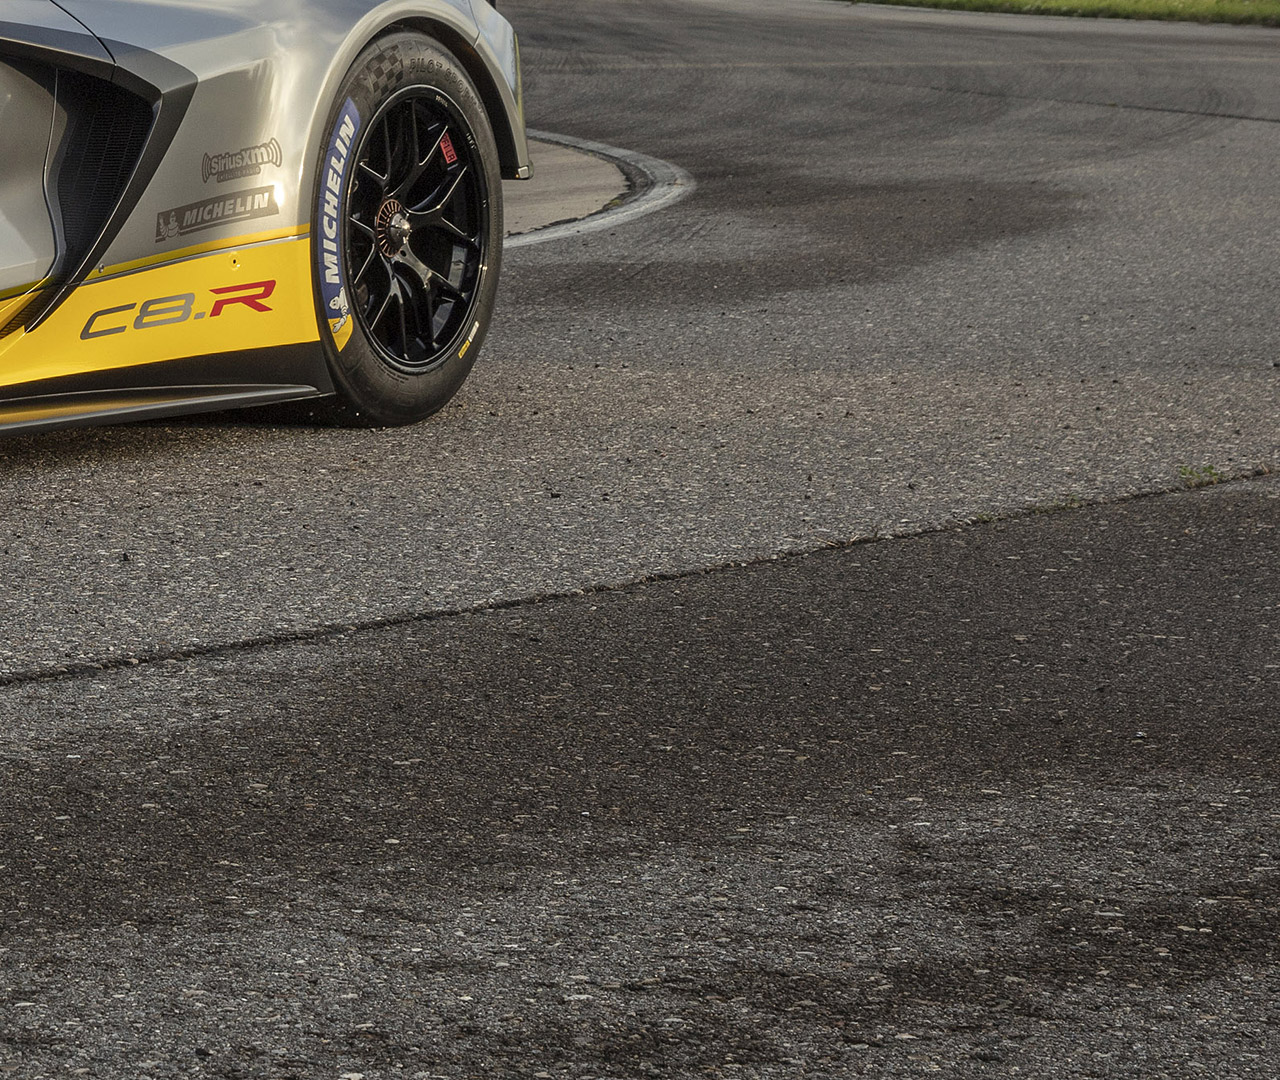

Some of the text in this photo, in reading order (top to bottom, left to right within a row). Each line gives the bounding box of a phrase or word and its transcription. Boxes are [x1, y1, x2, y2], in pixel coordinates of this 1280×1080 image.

[183, 192, 269, 227] MICHELIN
[322, 114, 355, 285] MICHELIN
[79, 279, 277, 340] C8.R
